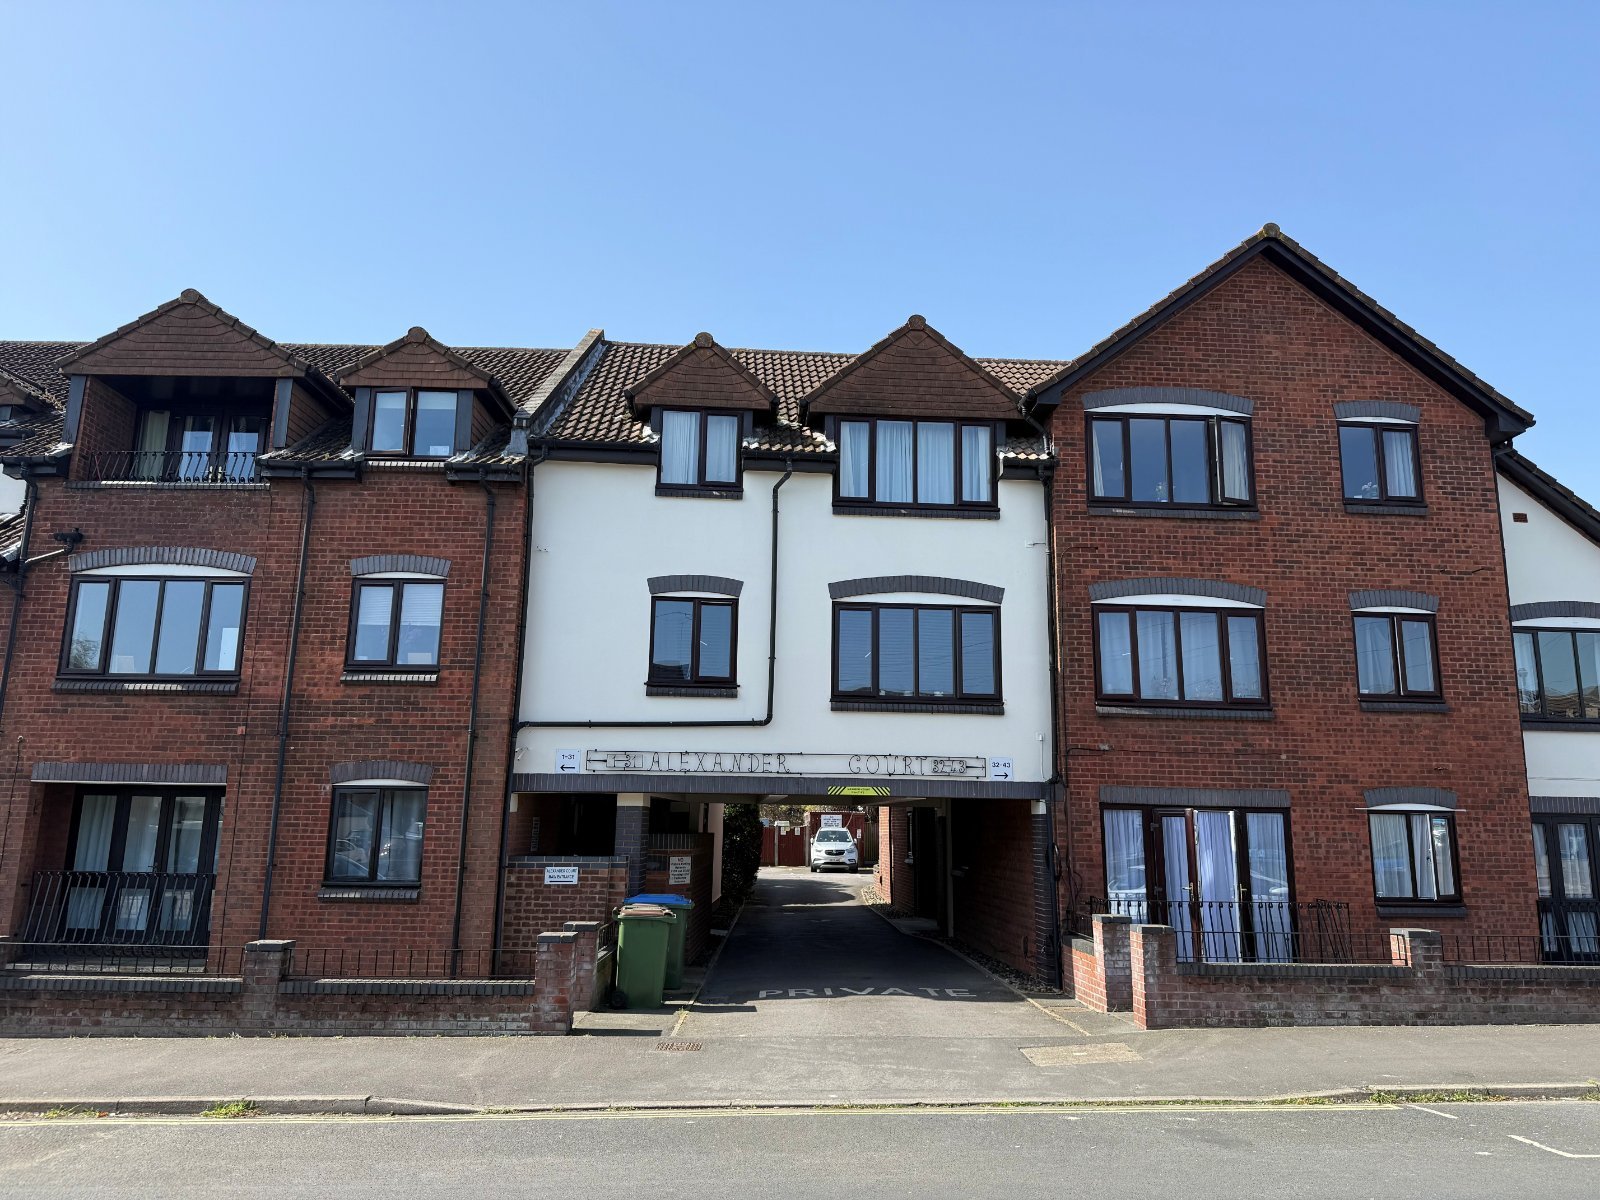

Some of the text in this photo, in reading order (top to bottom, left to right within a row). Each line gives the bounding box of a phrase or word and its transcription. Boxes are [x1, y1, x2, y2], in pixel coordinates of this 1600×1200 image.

[611, 754, 637, 768] 1-31
[647, 752, 790, 774] ALEXANDER
[848, 755, 928, 776] COURT
[758, 987, 977, 998] PRIVATE
